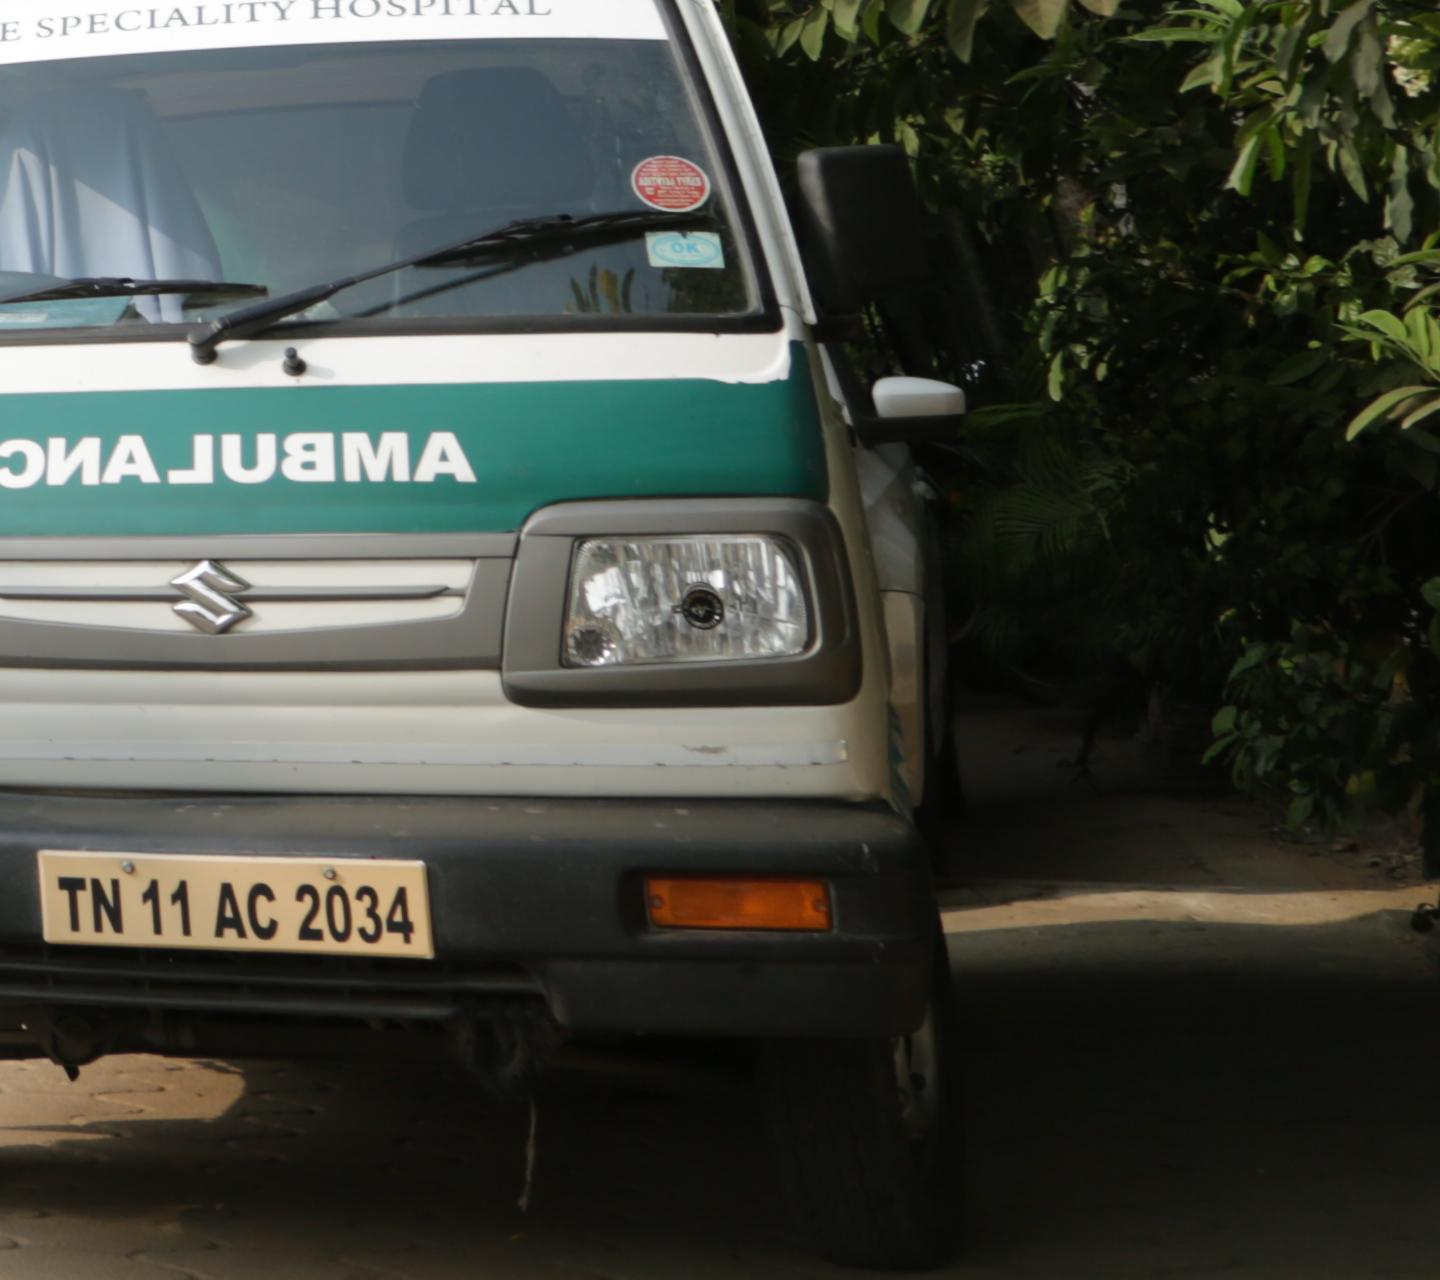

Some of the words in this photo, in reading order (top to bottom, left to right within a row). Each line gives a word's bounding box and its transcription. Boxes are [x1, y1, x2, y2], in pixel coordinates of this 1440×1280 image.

[670, 241, 701, 255] OK
[58, 876, 124, 934] TN
[142, 878, 192, 937] 11
[214, 882, 279, 940] AC
[295, 883, 415, 944] 2034
